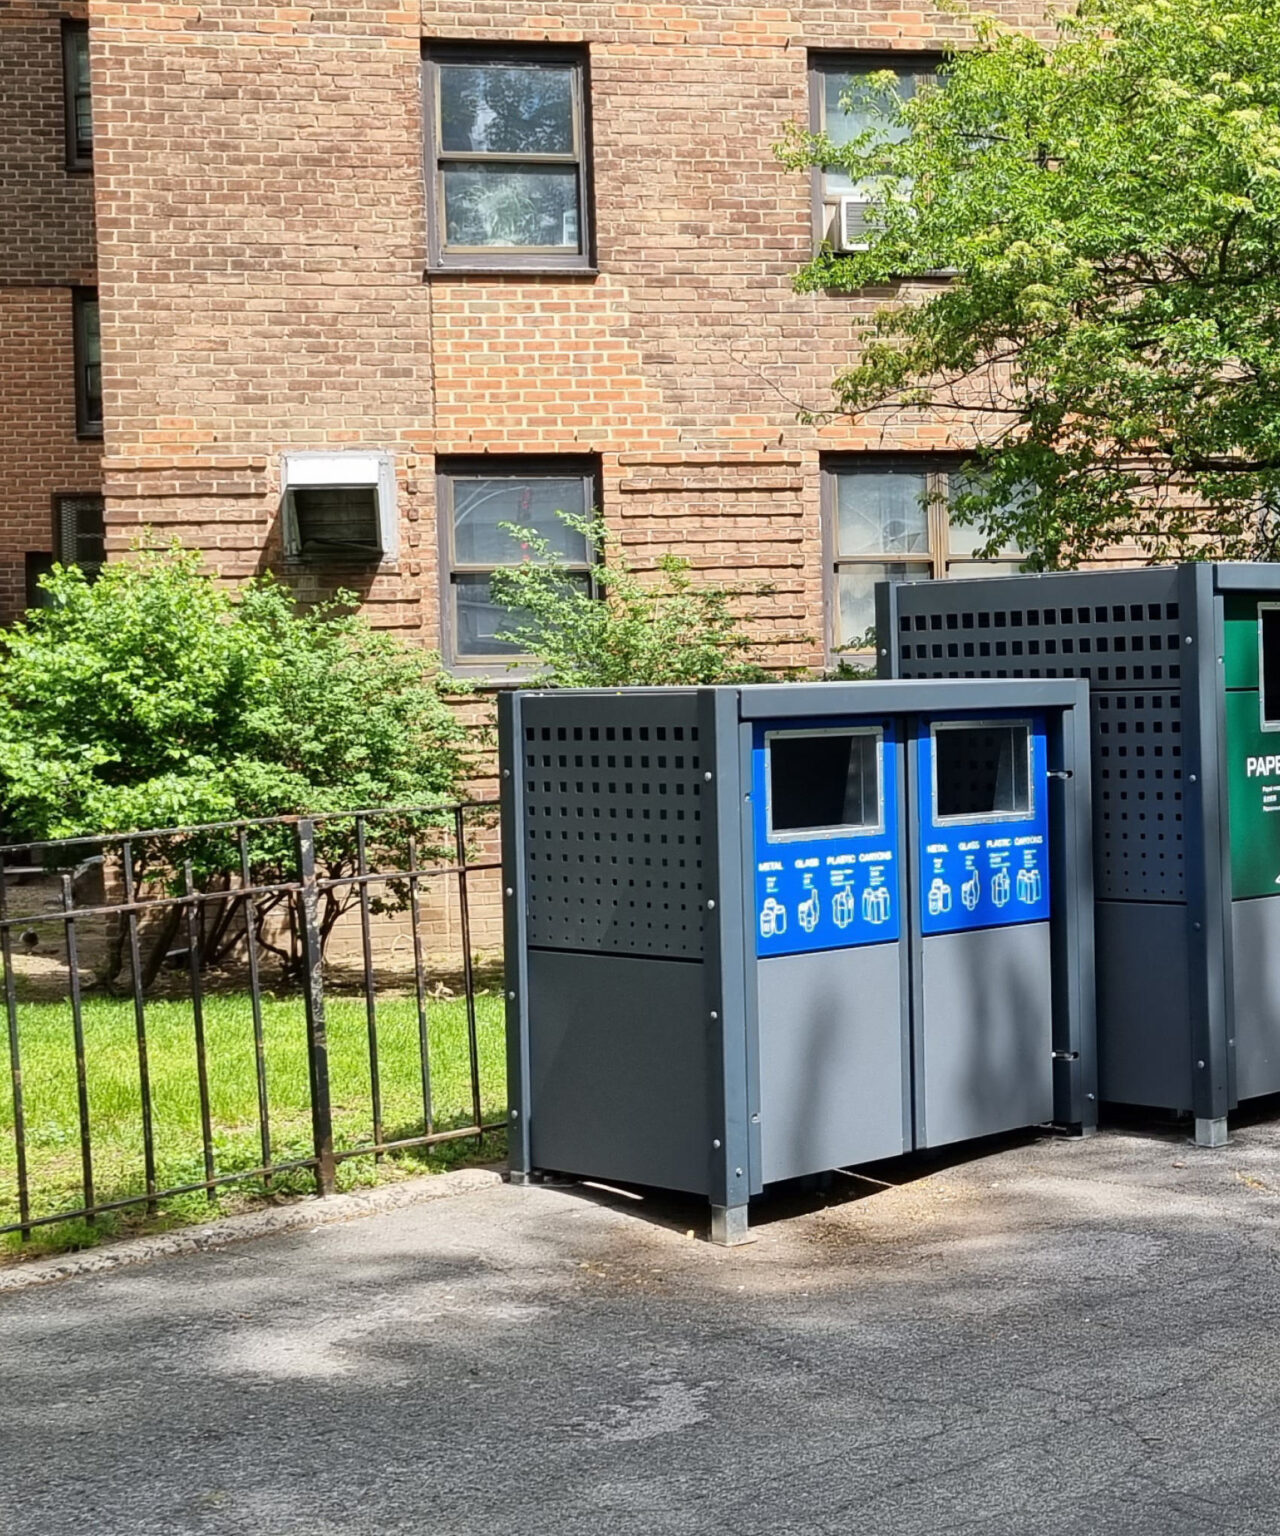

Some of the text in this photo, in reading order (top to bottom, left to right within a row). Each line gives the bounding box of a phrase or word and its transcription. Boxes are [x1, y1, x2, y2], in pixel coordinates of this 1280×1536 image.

[986, 838, 1012, 848] PLASTIC
[758, 850, 893, 872] METAL GLASS PLASTIC CARTONS
